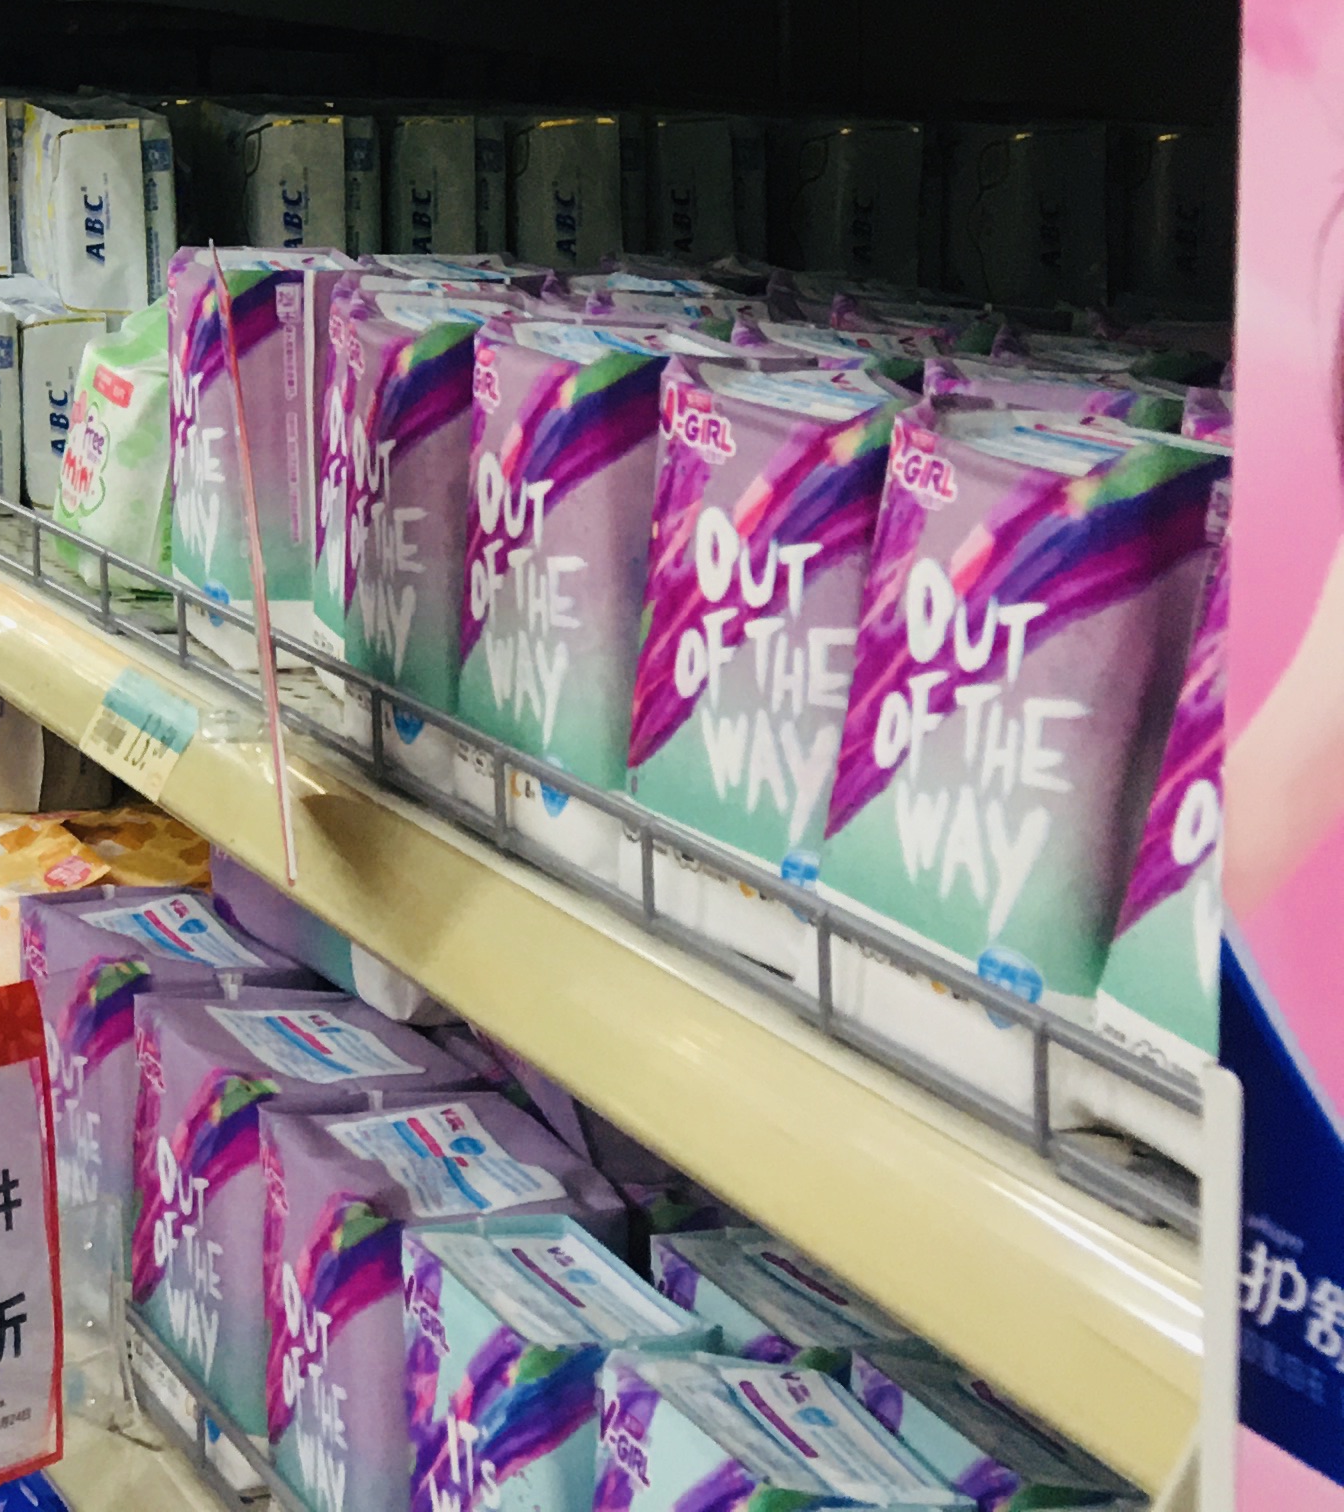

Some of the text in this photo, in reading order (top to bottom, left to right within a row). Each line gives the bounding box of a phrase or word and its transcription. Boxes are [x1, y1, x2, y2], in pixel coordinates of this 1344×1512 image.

[84, 192, 107, 267] ABC
[352, 415, 397, 494] OUT
[478, 451, 554, 548] OUT
[370, 500, 429, 577] THE
[469, 539, 588, 635] OF THE
[696, 505, 823, 618] OUT
[674, 606, 858, 715] OF THE
[905, 557, 1047, 684] OUT
[484, 628, 569, 751] WAY
[873, 672, 1094, 794] OF THE
[701, 705, 841, 849] WAY
[895, 780, 1051, 945] WAY
[156, 1136, 210, 1217] OUT
[283, 1261, 333, 1355] OUT
